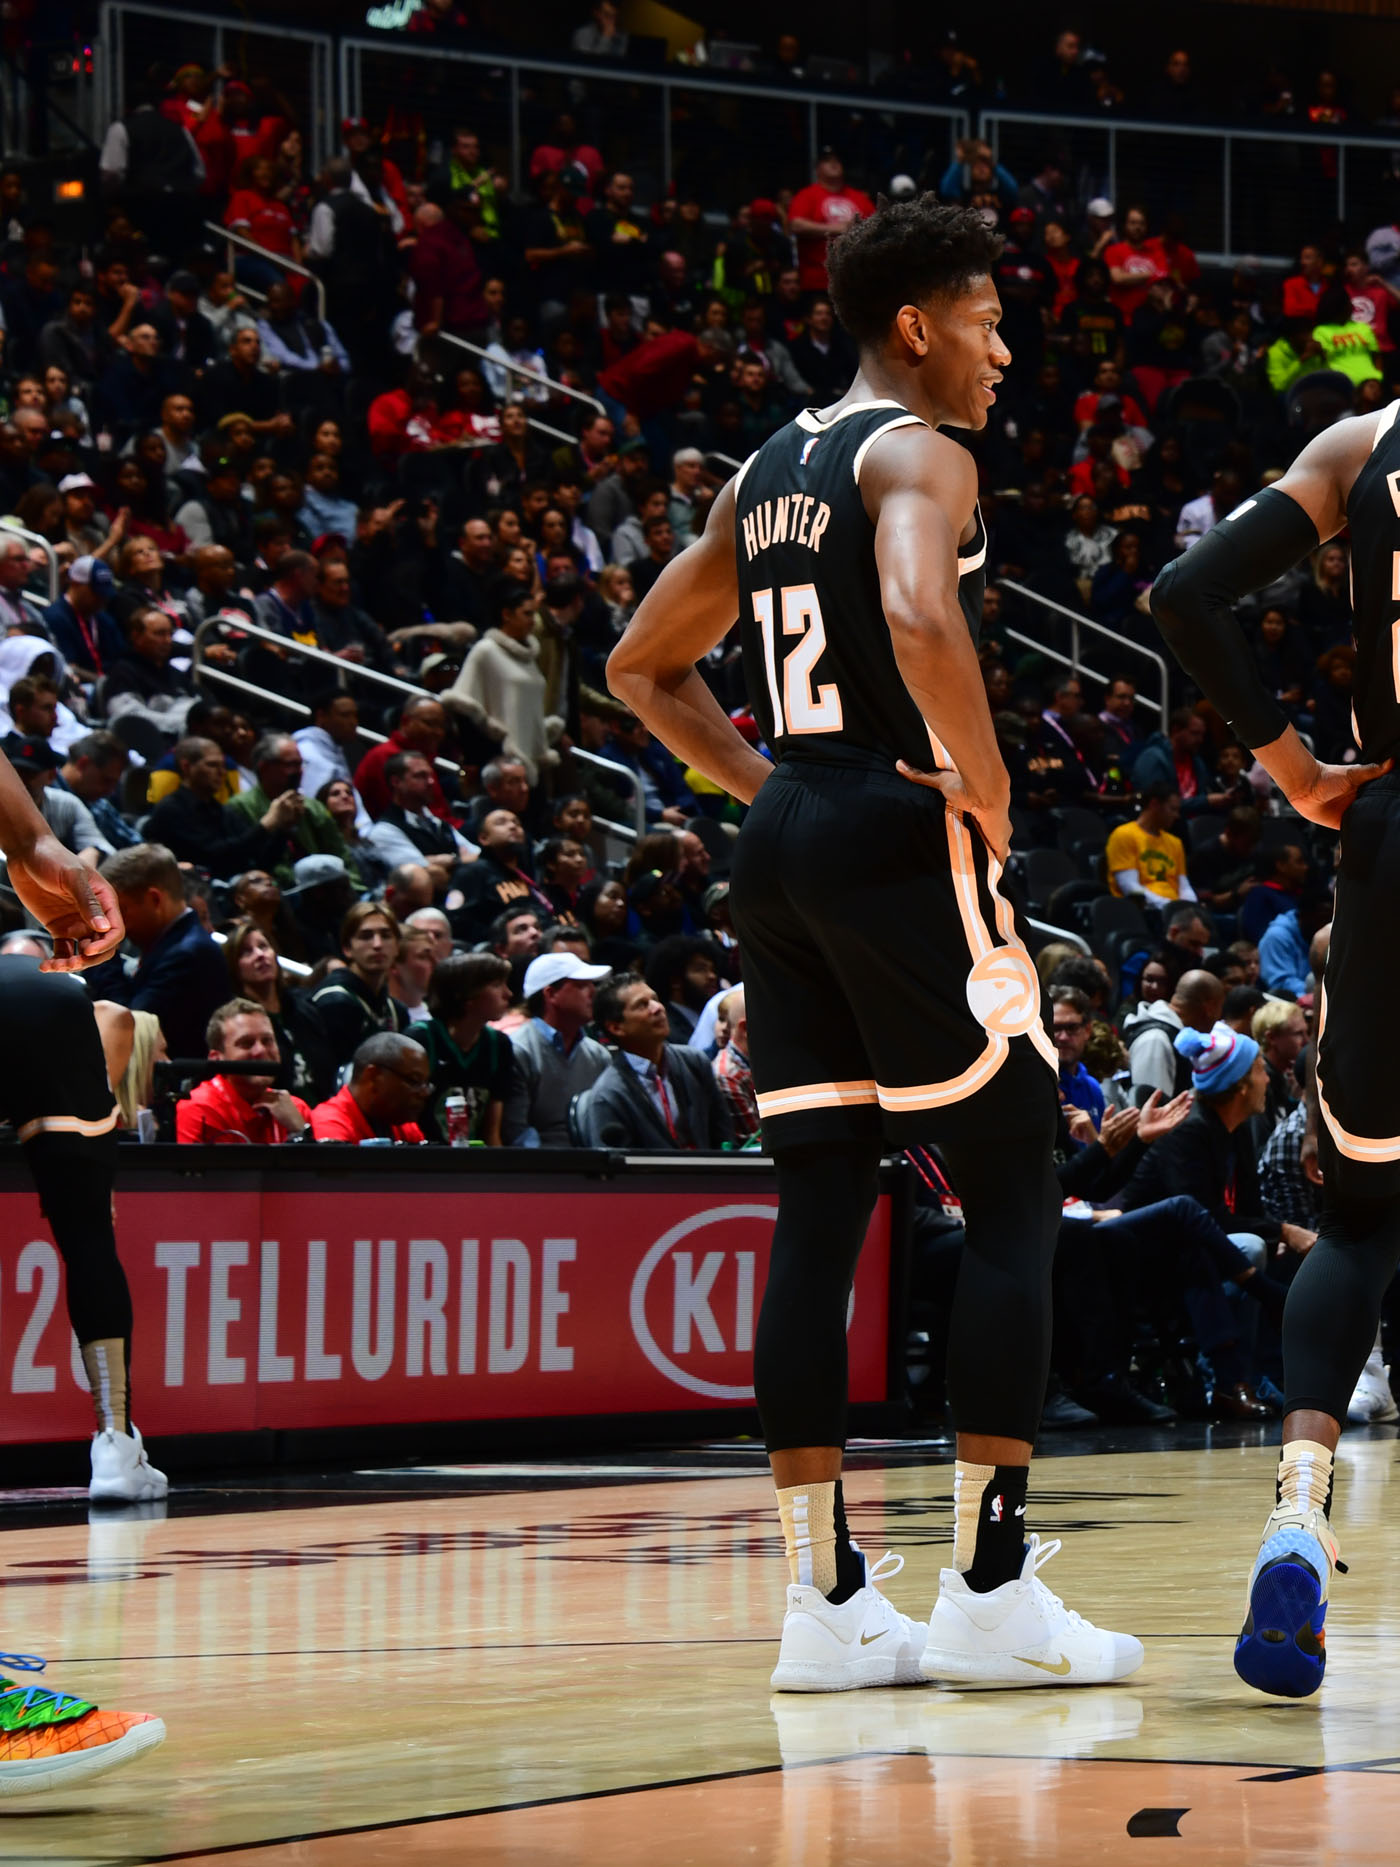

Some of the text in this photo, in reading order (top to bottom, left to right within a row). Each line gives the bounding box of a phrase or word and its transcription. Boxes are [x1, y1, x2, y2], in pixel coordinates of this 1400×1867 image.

[742, 493, 831, 562] HUNTER
[752, 583, 844, 738] 12
[154, 1237, 578, 1388] TELLURIDE
[671, 1251, 755, 1354] KI
